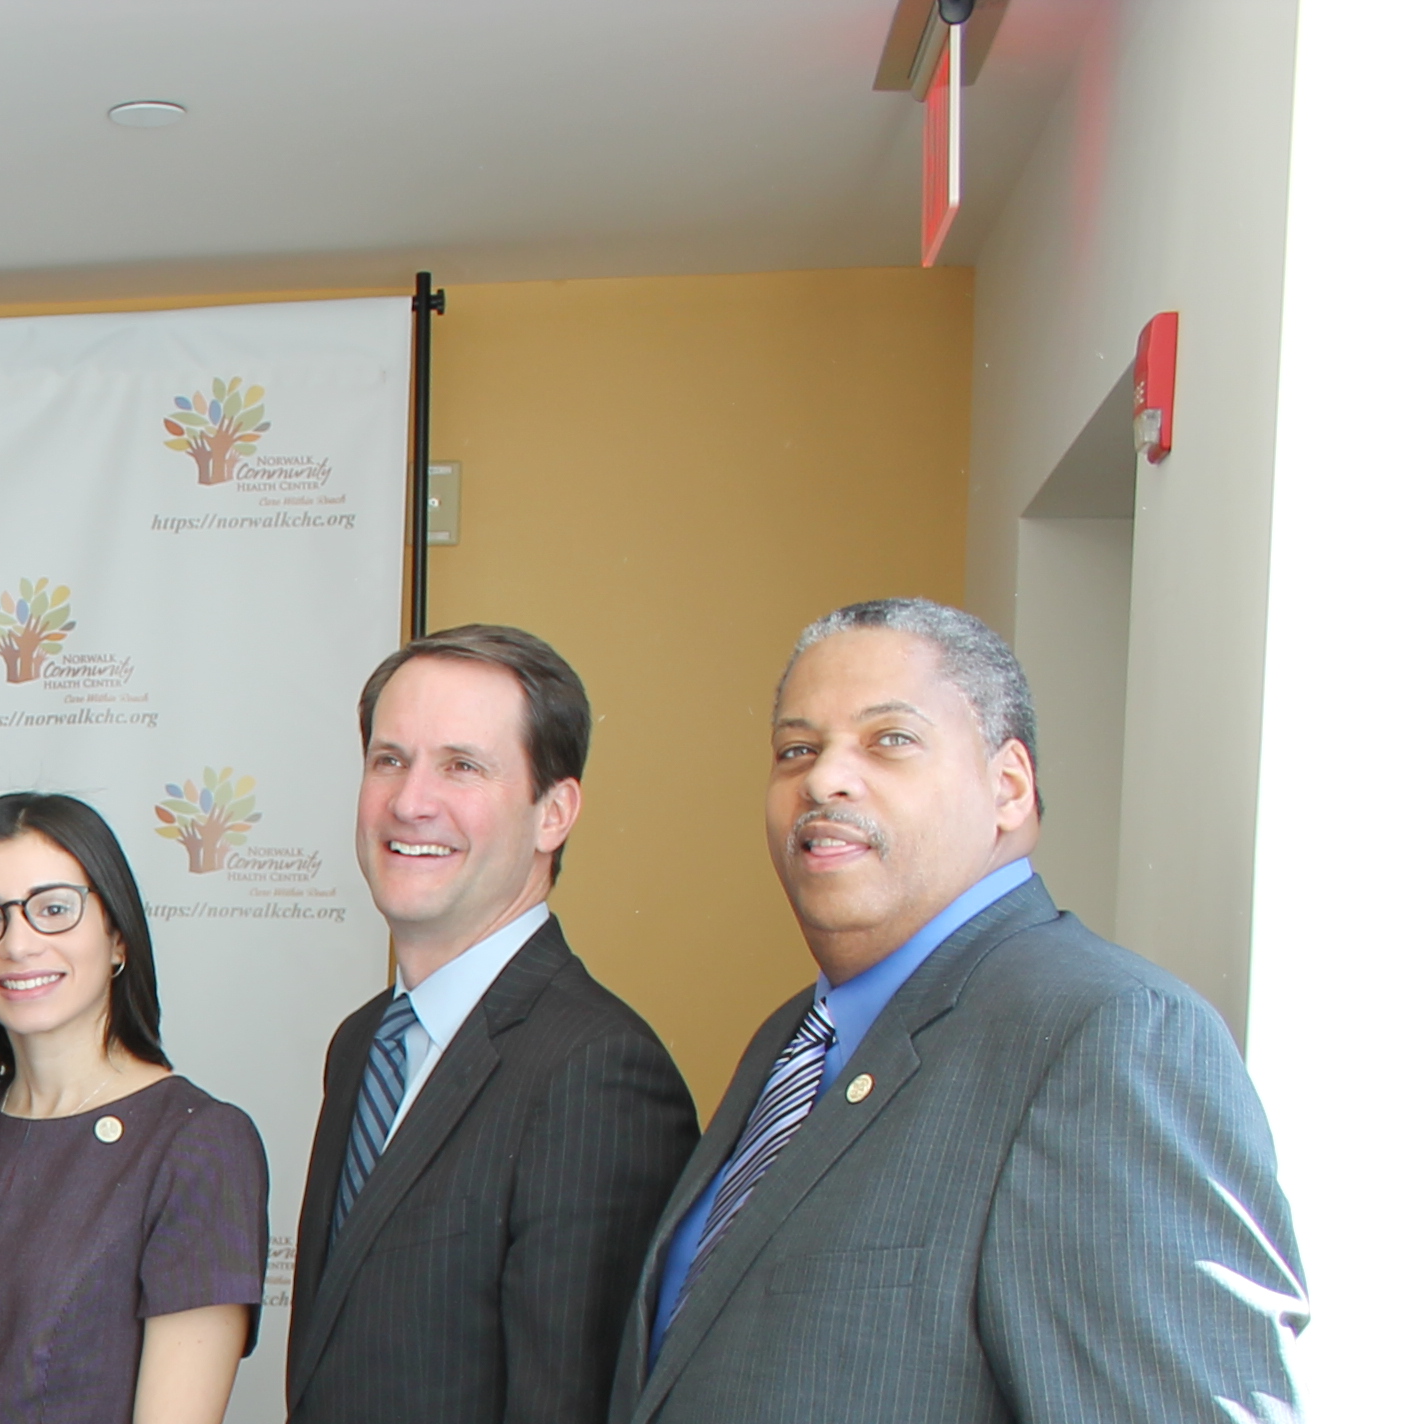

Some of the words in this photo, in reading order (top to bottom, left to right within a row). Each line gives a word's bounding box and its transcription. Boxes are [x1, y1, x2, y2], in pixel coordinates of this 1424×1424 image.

[257, 456, 313, 465] NORWALK
[237, 458, 332, 485] Community
[237, 483, 276, 492] HEALTH
[280, 482, 319, 491] CENTER
[151, 511, 355, 534] https://norwalkchc.org
[63, 655, 116, 664] NORWALK
[43, 656, 134, 683] Community
[44, 680, 80, 689] HEALTH
[83, 679, 122, 688] CENTER
